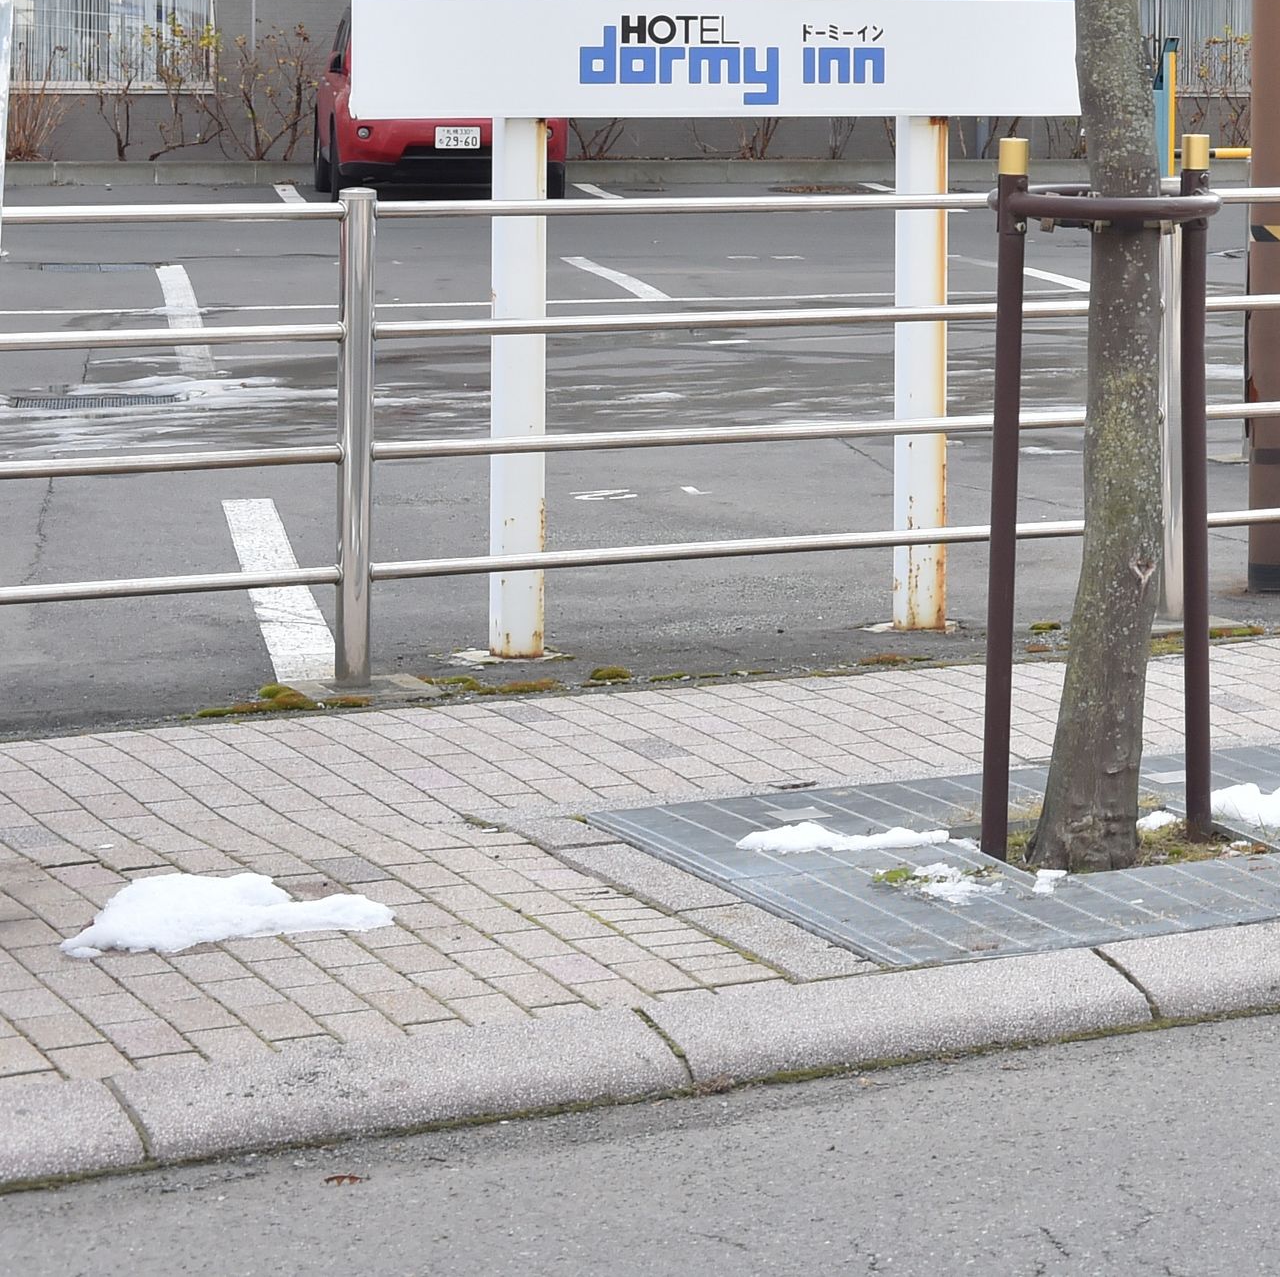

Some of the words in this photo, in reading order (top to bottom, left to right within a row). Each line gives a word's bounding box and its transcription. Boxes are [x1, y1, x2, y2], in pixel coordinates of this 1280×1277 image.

[621, 15, 740, 45] HOTEL
[802, 24, 884, 43] ドーミーイン
[579, 25, 779, 105] dormy
[802, 47, 885, 84] inn
[445, 136, 478, 147] 29-60
